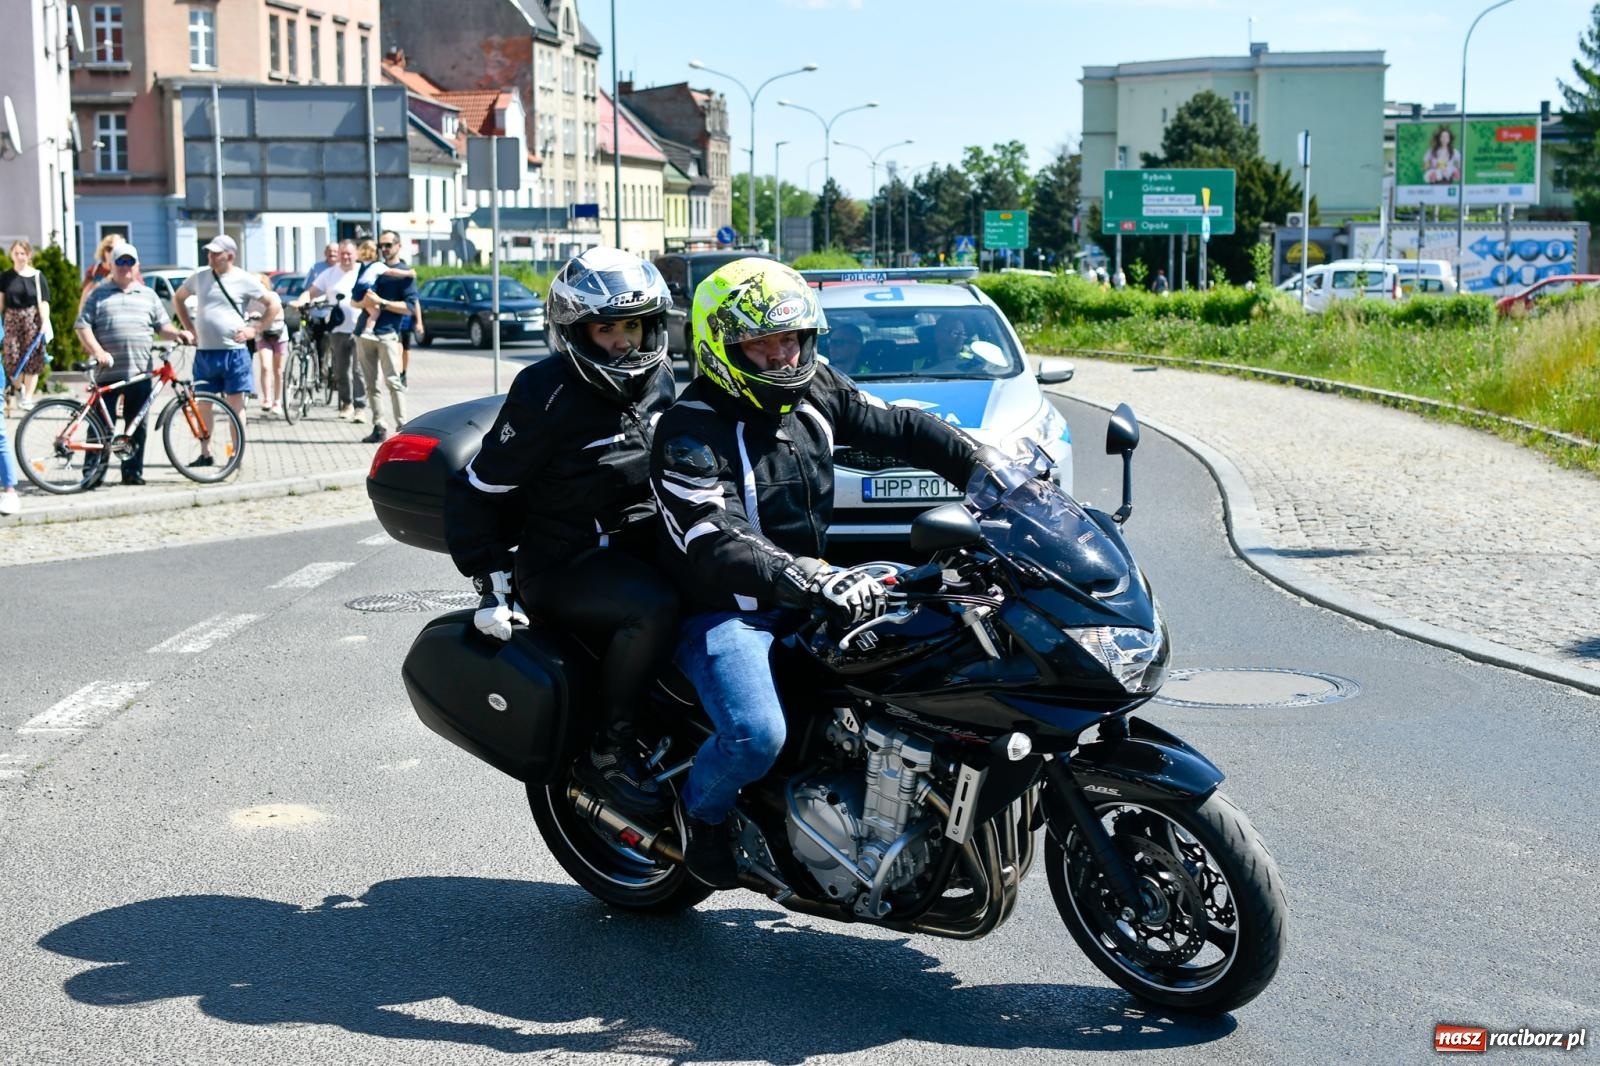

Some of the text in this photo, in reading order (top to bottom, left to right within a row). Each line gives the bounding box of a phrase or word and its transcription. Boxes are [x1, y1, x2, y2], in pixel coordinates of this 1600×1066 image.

[1142, 172, 1173, 181] Rybnik
[1142, 184, 1176, 192] Gliwice
[1141, 221, 1169, 231] Opole
[842, 273, 886, 282] POLICJA
[770, 304, 802, 318] SUOM
[875, 480, 912, 497] HPP
[1083, 784, 1120, 795] ABS
